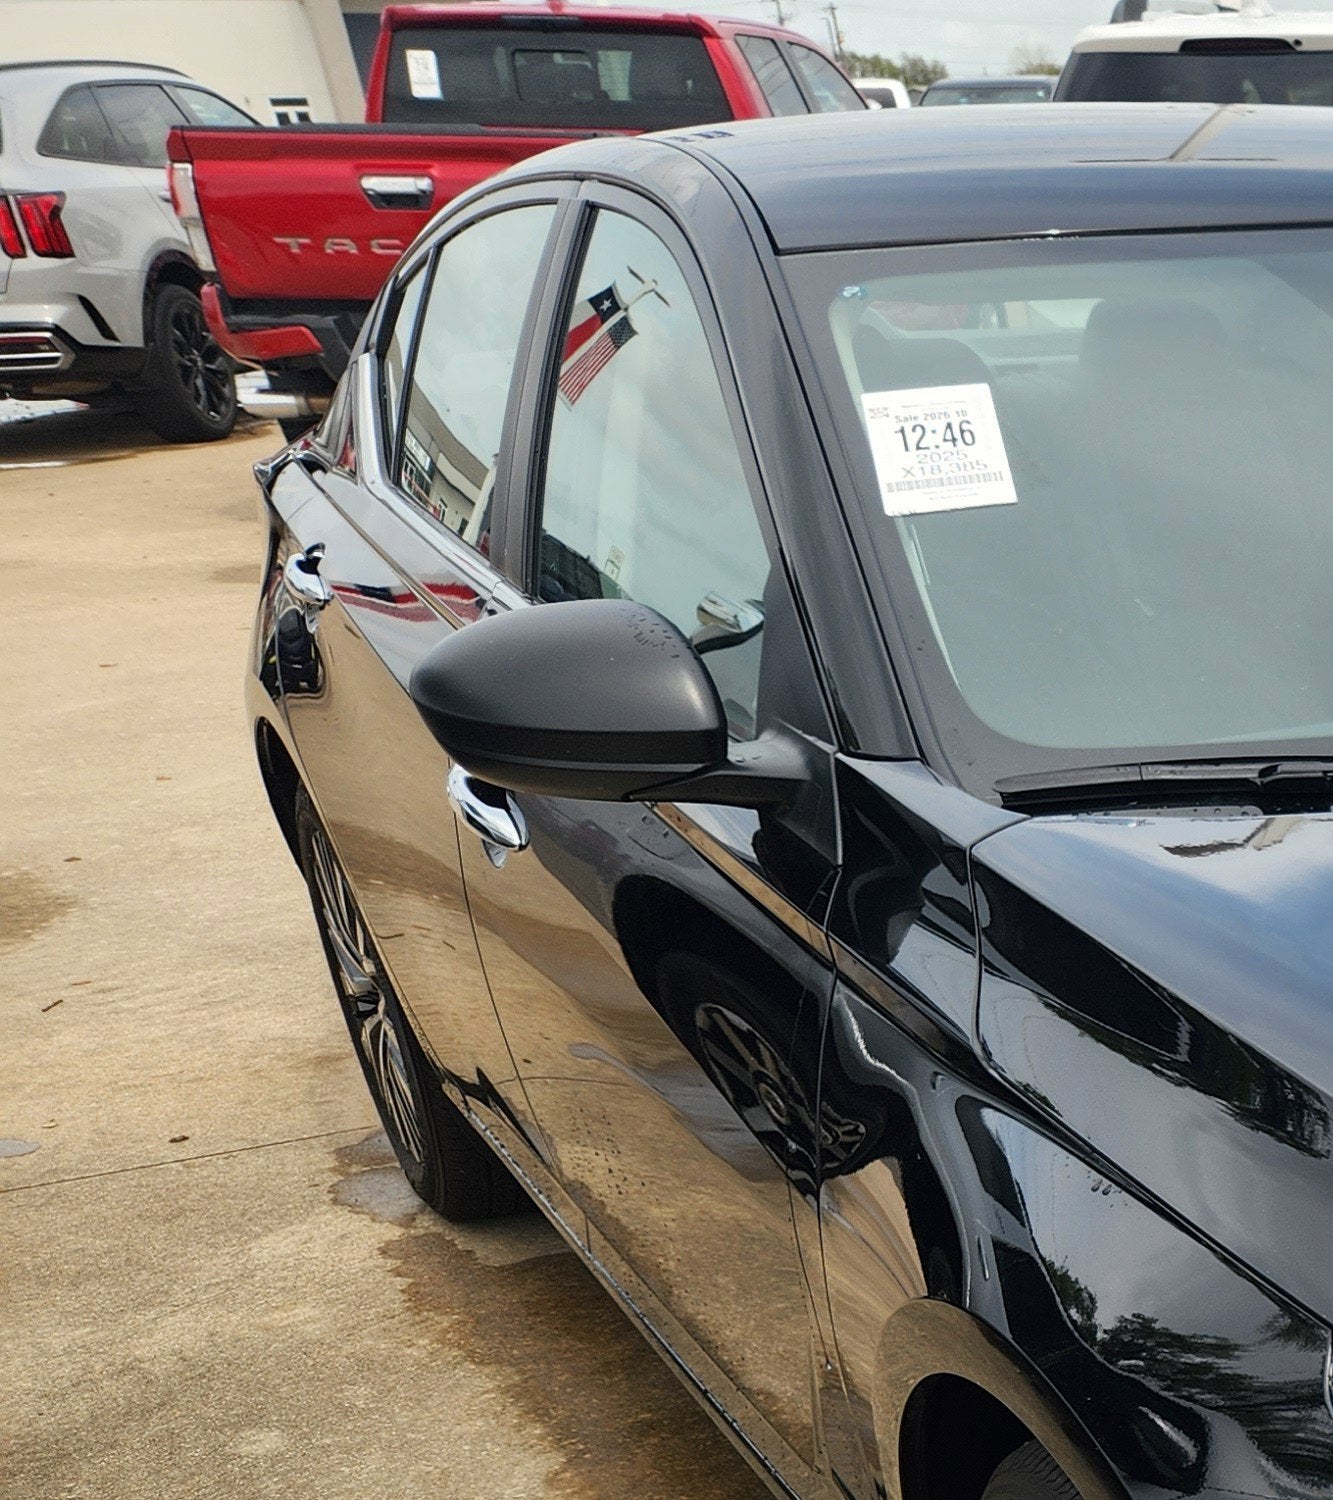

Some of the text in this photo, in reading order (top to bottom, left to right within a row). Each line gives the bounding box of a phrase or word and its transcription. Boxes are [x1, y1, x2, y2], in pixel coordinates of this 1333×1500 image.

[894, 412, 919, 424] Sale
[923, 411, 950, 422] 2026
[894, 420, 976, 452] 12:46
[916, 449, 968, 464] 2025
